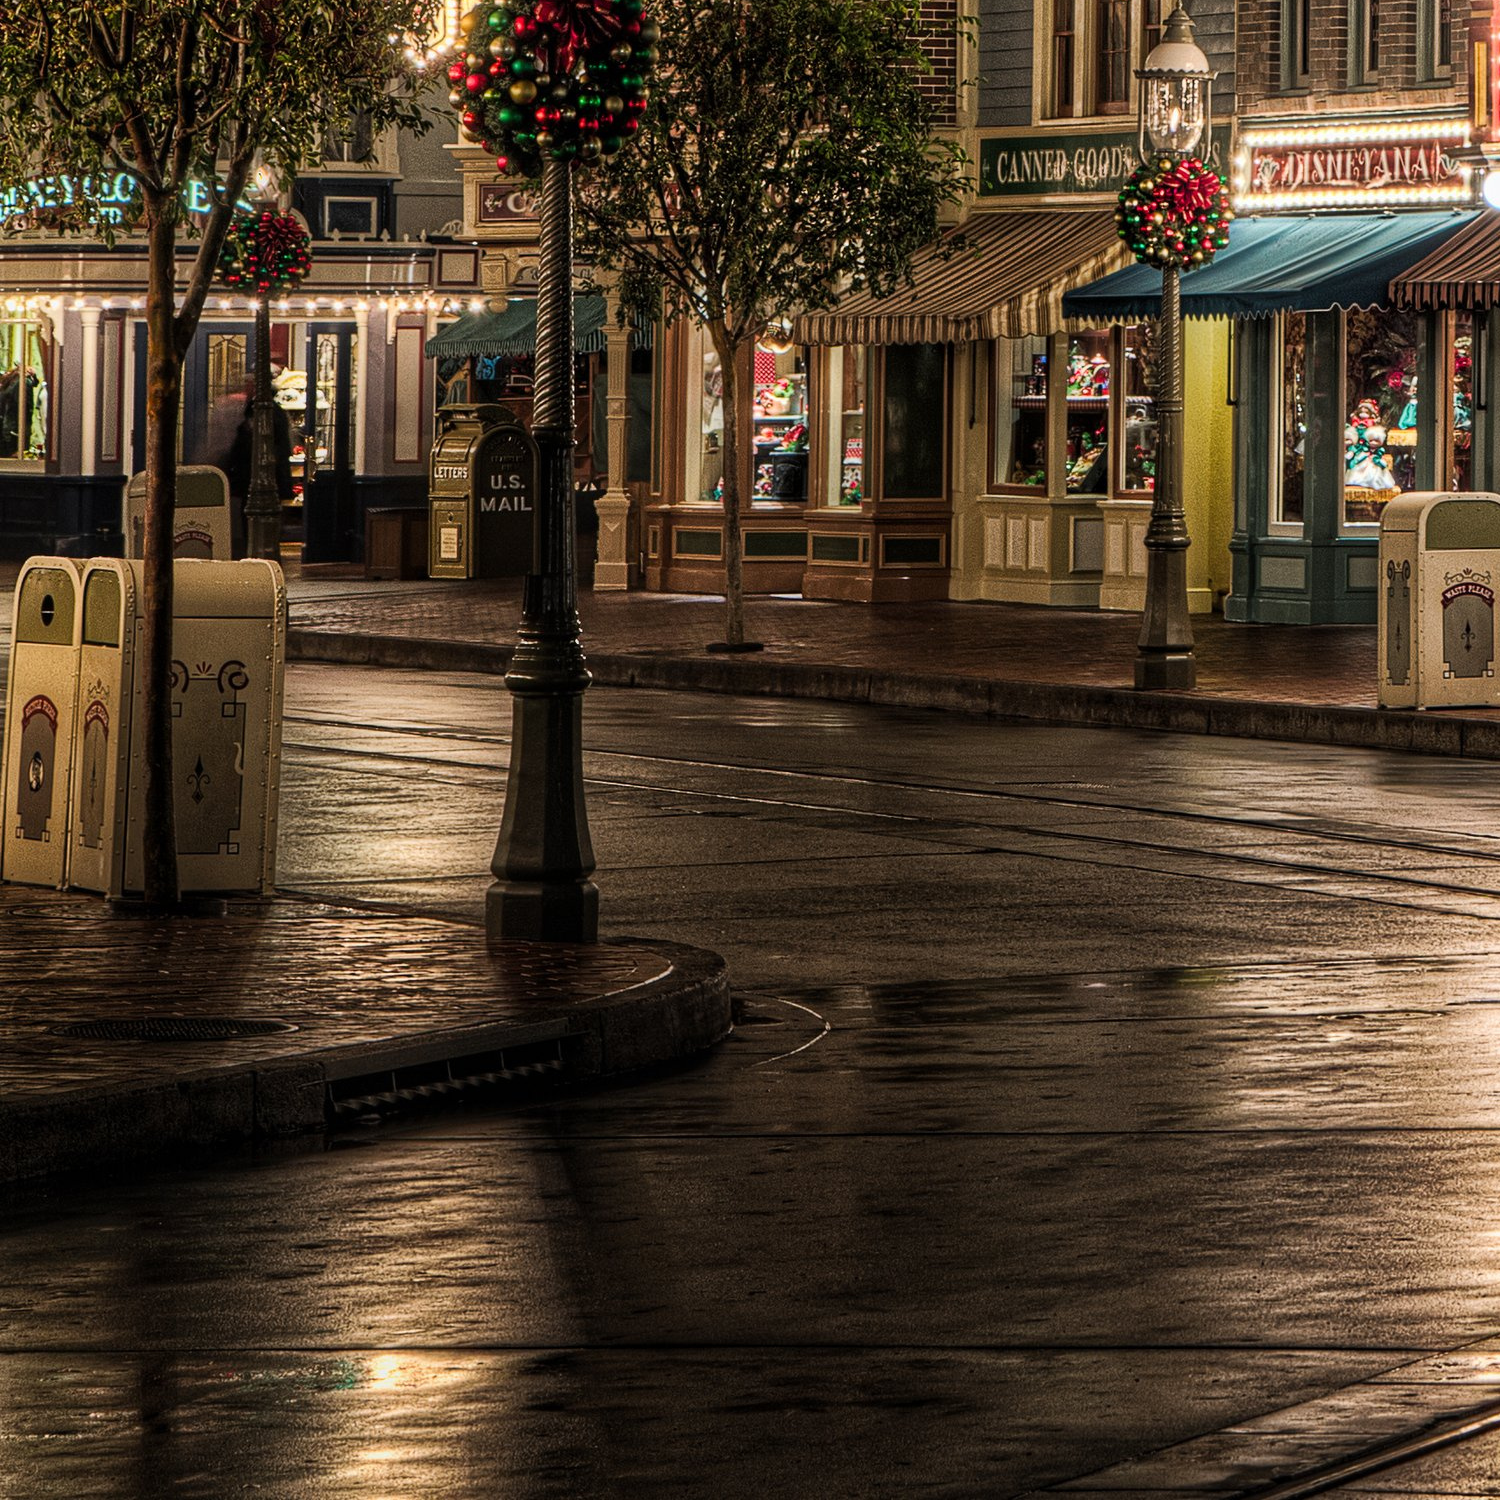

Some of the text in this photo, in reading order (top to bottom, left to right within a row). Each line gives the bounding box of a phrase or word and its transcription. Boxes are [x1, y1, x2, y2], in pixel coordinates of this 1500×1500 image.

[997, 145, 1134, 184] CANNED GOODS
[1284, 145, 1432, 191] DISNEYANA
[433, 466, 468, 479] LETTERS
[491, 475, 526, 490] U.S.
[480, 496, 533, 512] MAIL
[1468, 585, 1492, 599] PLEASE
